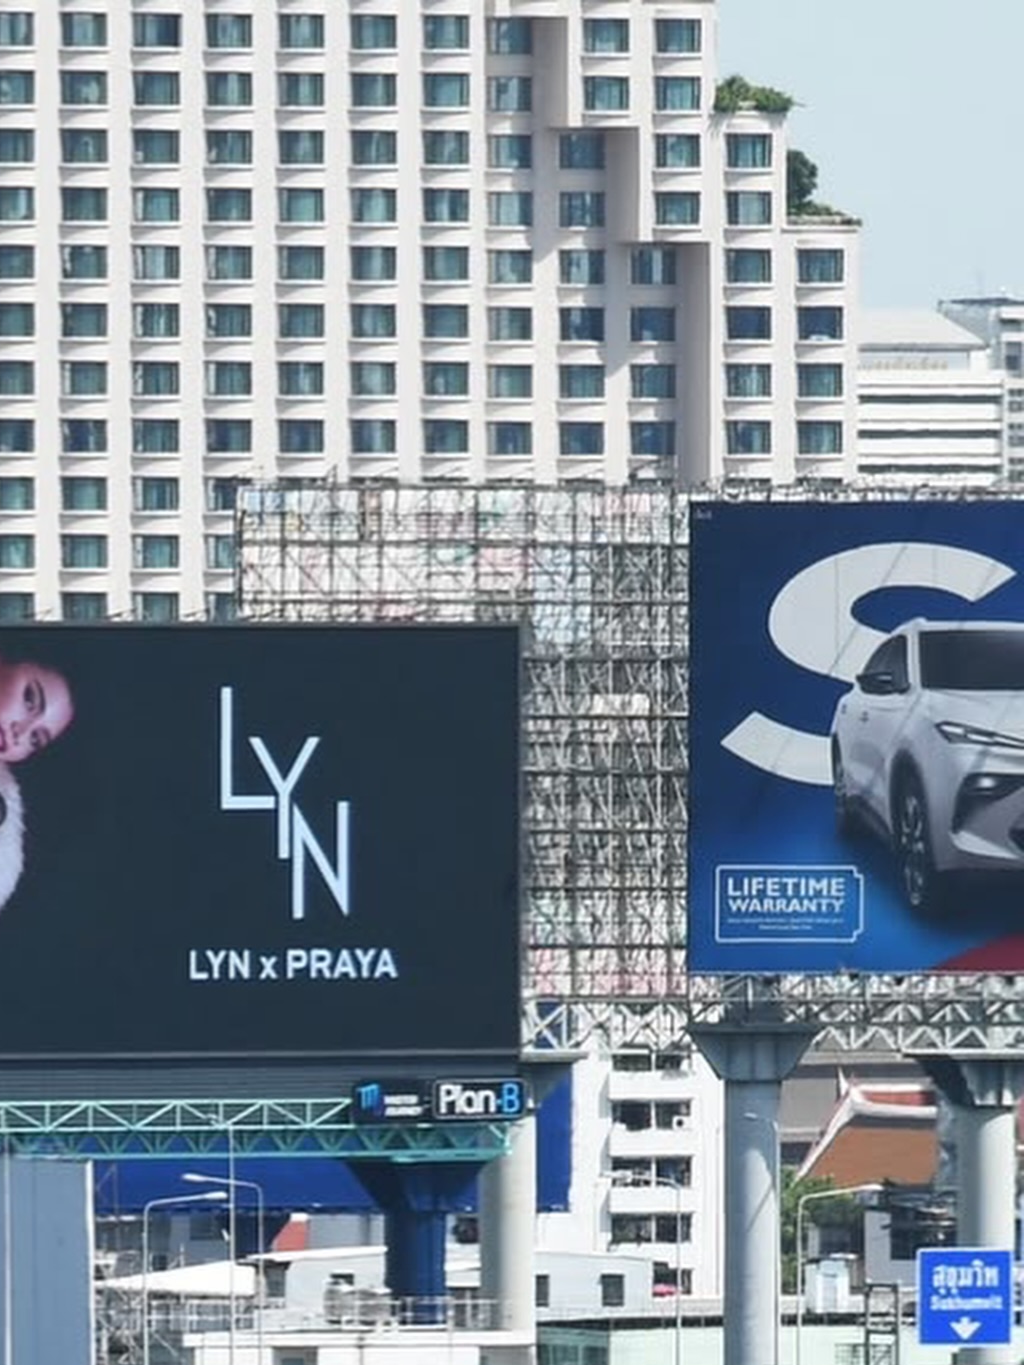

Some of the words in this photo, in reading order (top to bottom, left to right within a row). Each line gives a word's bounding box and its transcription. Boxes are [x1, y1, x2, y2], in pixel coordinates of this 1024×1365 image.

[221, 686, 350, 919] LYN
[727, 877, 846, 897] LIFETIME
[728, 898, 844, 913] WARRANTY
[189, 949, 251, 980] LYN
[260, 957, 277, 979] x
[286, 948, 399, 979] PRAYA
